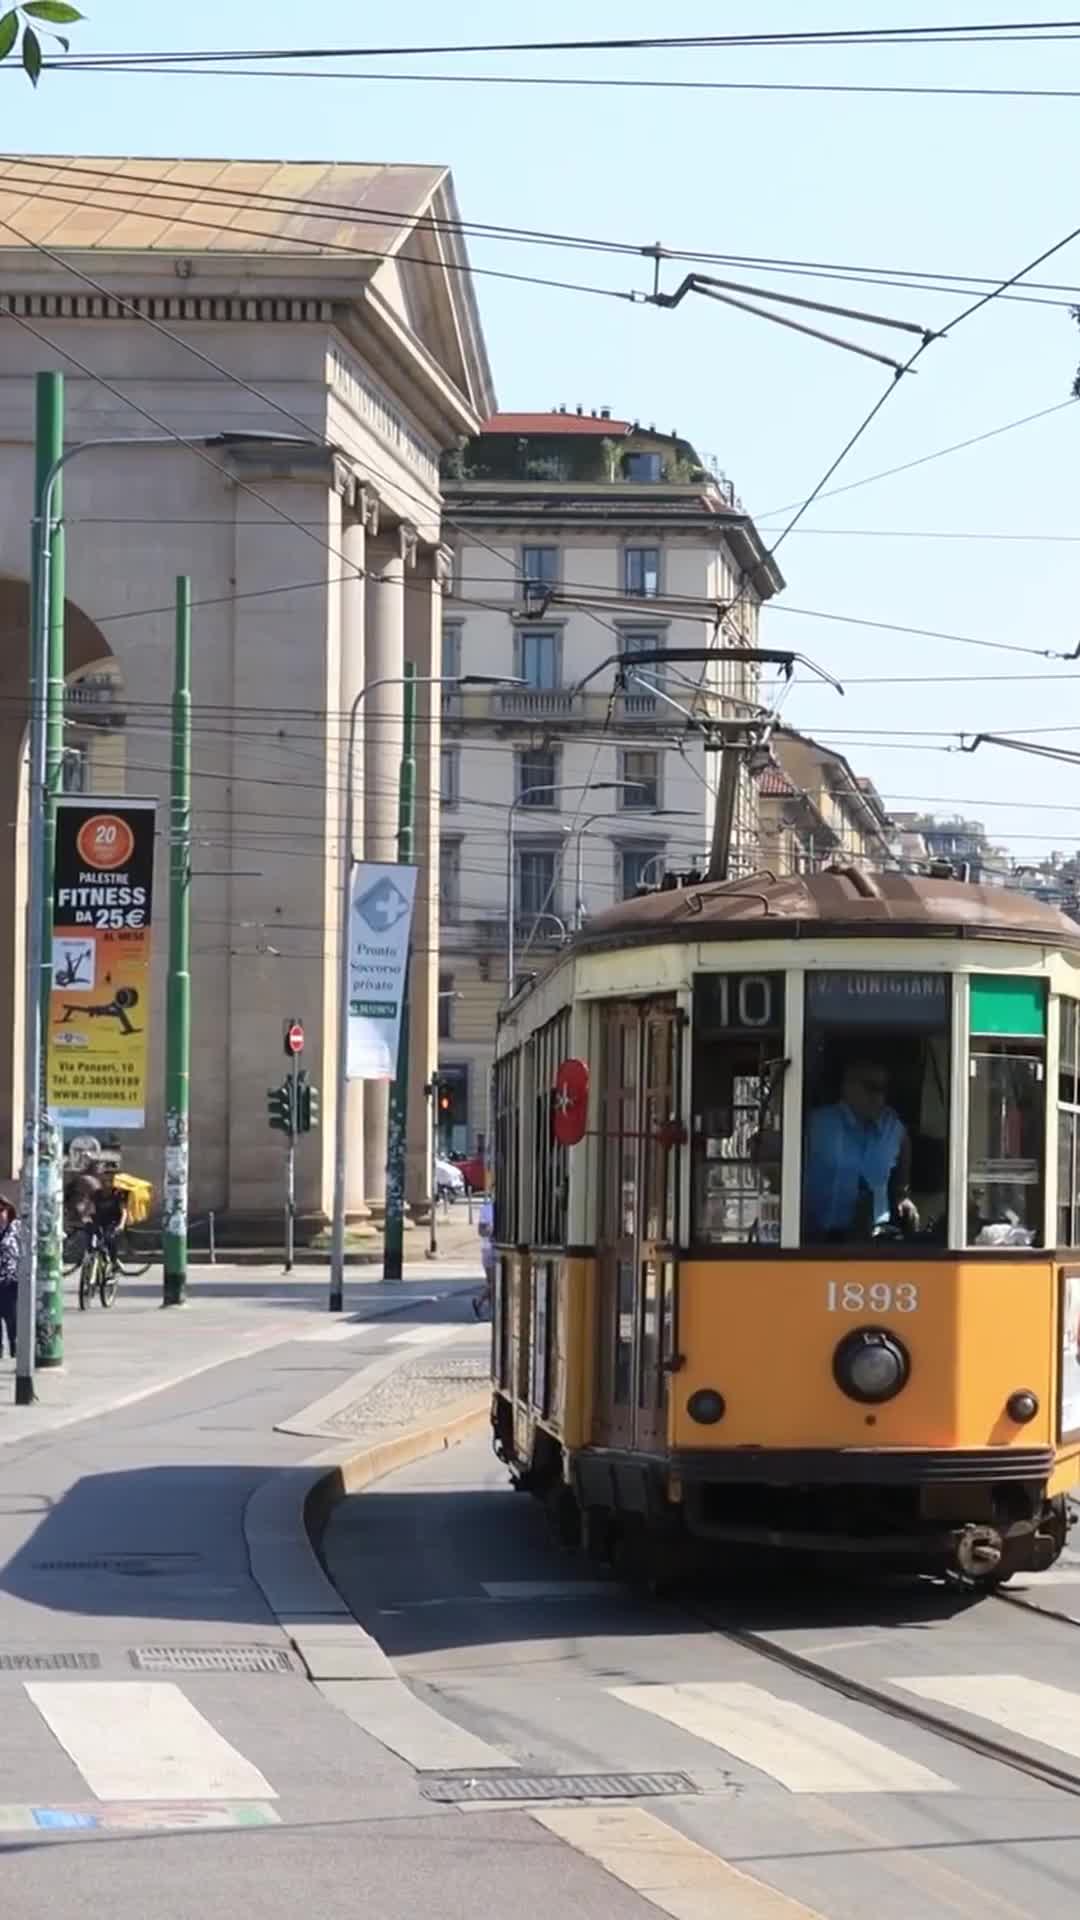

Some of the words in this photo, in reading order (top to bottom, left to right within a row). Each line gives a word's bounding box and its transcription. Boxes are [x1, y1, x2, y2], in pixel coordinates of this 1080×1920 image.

[79, 872, 129, 885] PALESTRE
[58, 887, 146, 907] FITNESS
[75, 911, 93, 923] DA
[95, 908, 145, 930] 25€
[356, 943, 398, 957] Pronto
[353, 980, 395, 993] privato
[717, 975, 772, 1027] 10
[59, 1061, 75, 1073] Via
[827, 1280, 918, 1313] 1893
